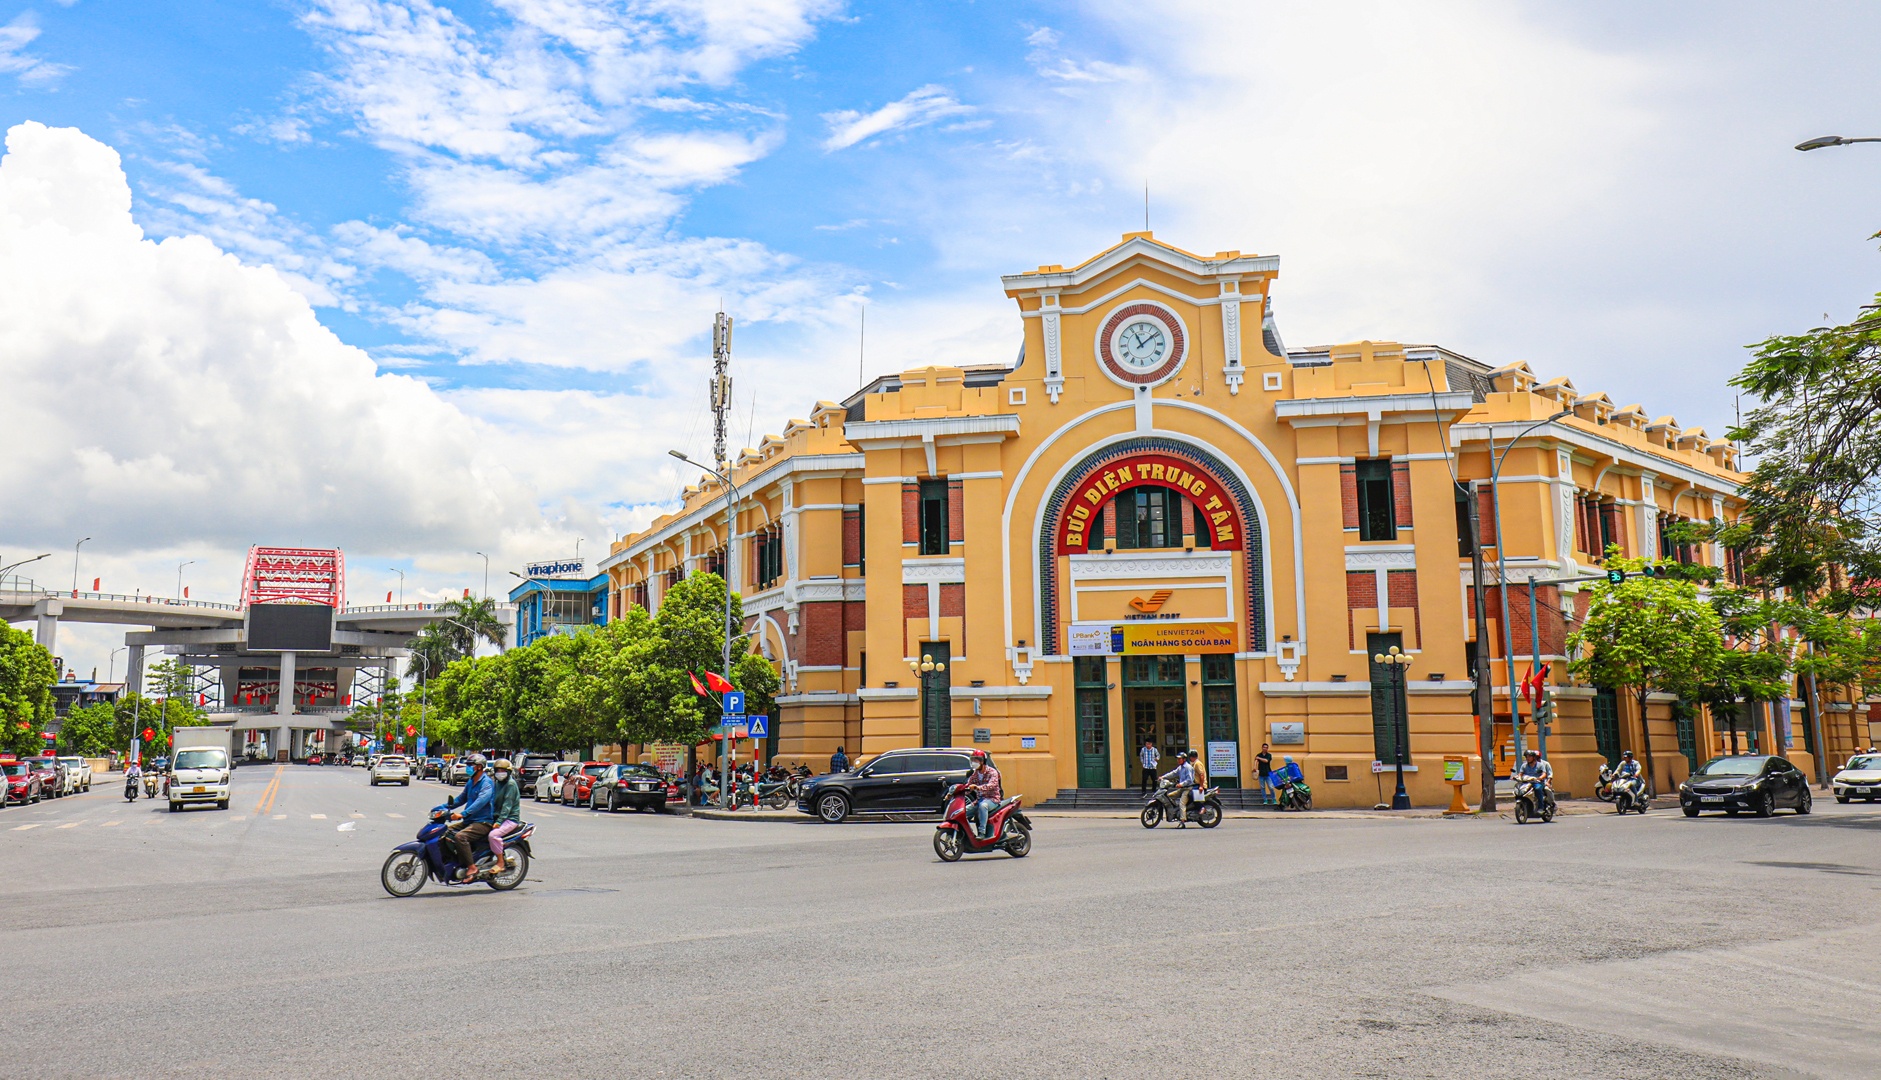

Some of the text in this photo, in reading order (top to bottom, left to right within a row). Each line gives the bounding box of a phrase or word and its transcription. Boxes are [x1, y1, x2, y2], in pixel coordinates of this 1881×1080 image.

[1066, 463, 1235, 546] BƯU ĐIỆN TRUNG TÂM
[528, 562, 582, 576] vinaphone
[1160, 612, 1181, 620] POST
[1131, 636, 1231, 648] NGÂN HÀNG SỐ CỦA BẠN
[730, 696, 739, 710] P
